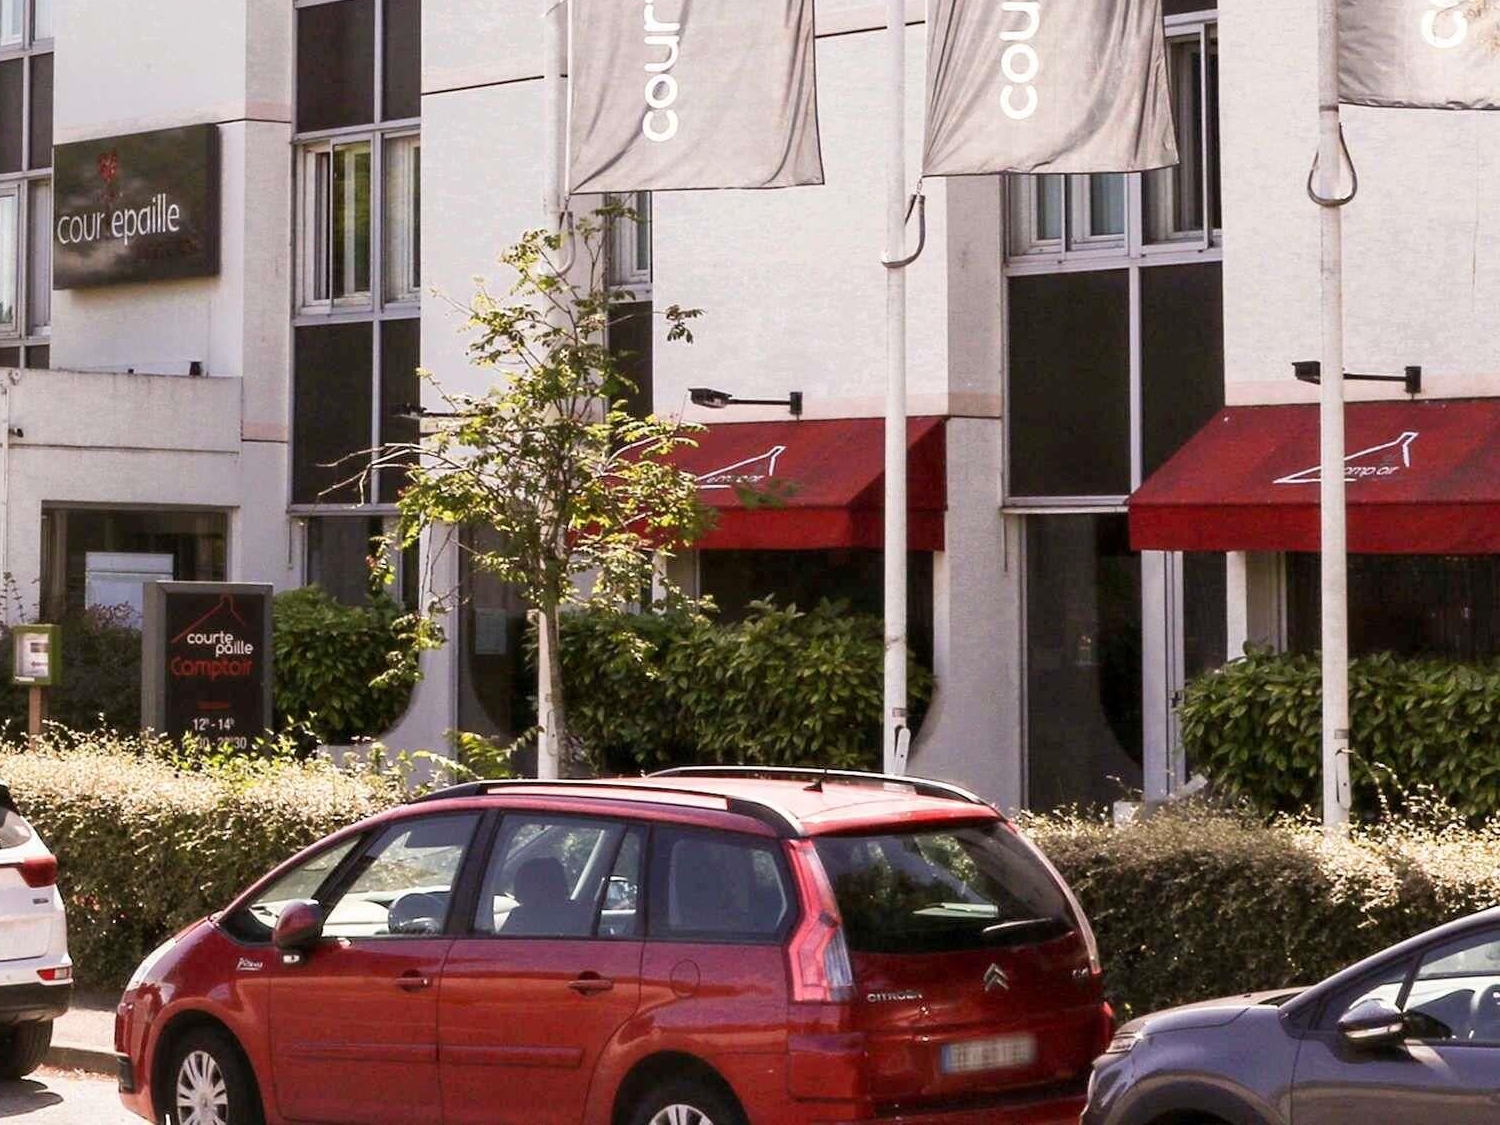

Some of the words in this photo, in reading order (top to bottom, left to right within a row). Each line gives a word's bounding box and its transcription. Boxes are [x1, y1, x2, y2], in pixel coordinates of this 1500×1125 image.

[187, 631, 234, 644] courte
[215, 641, 254, 657] paille
[171, 657, 253, 681] Comptoir
